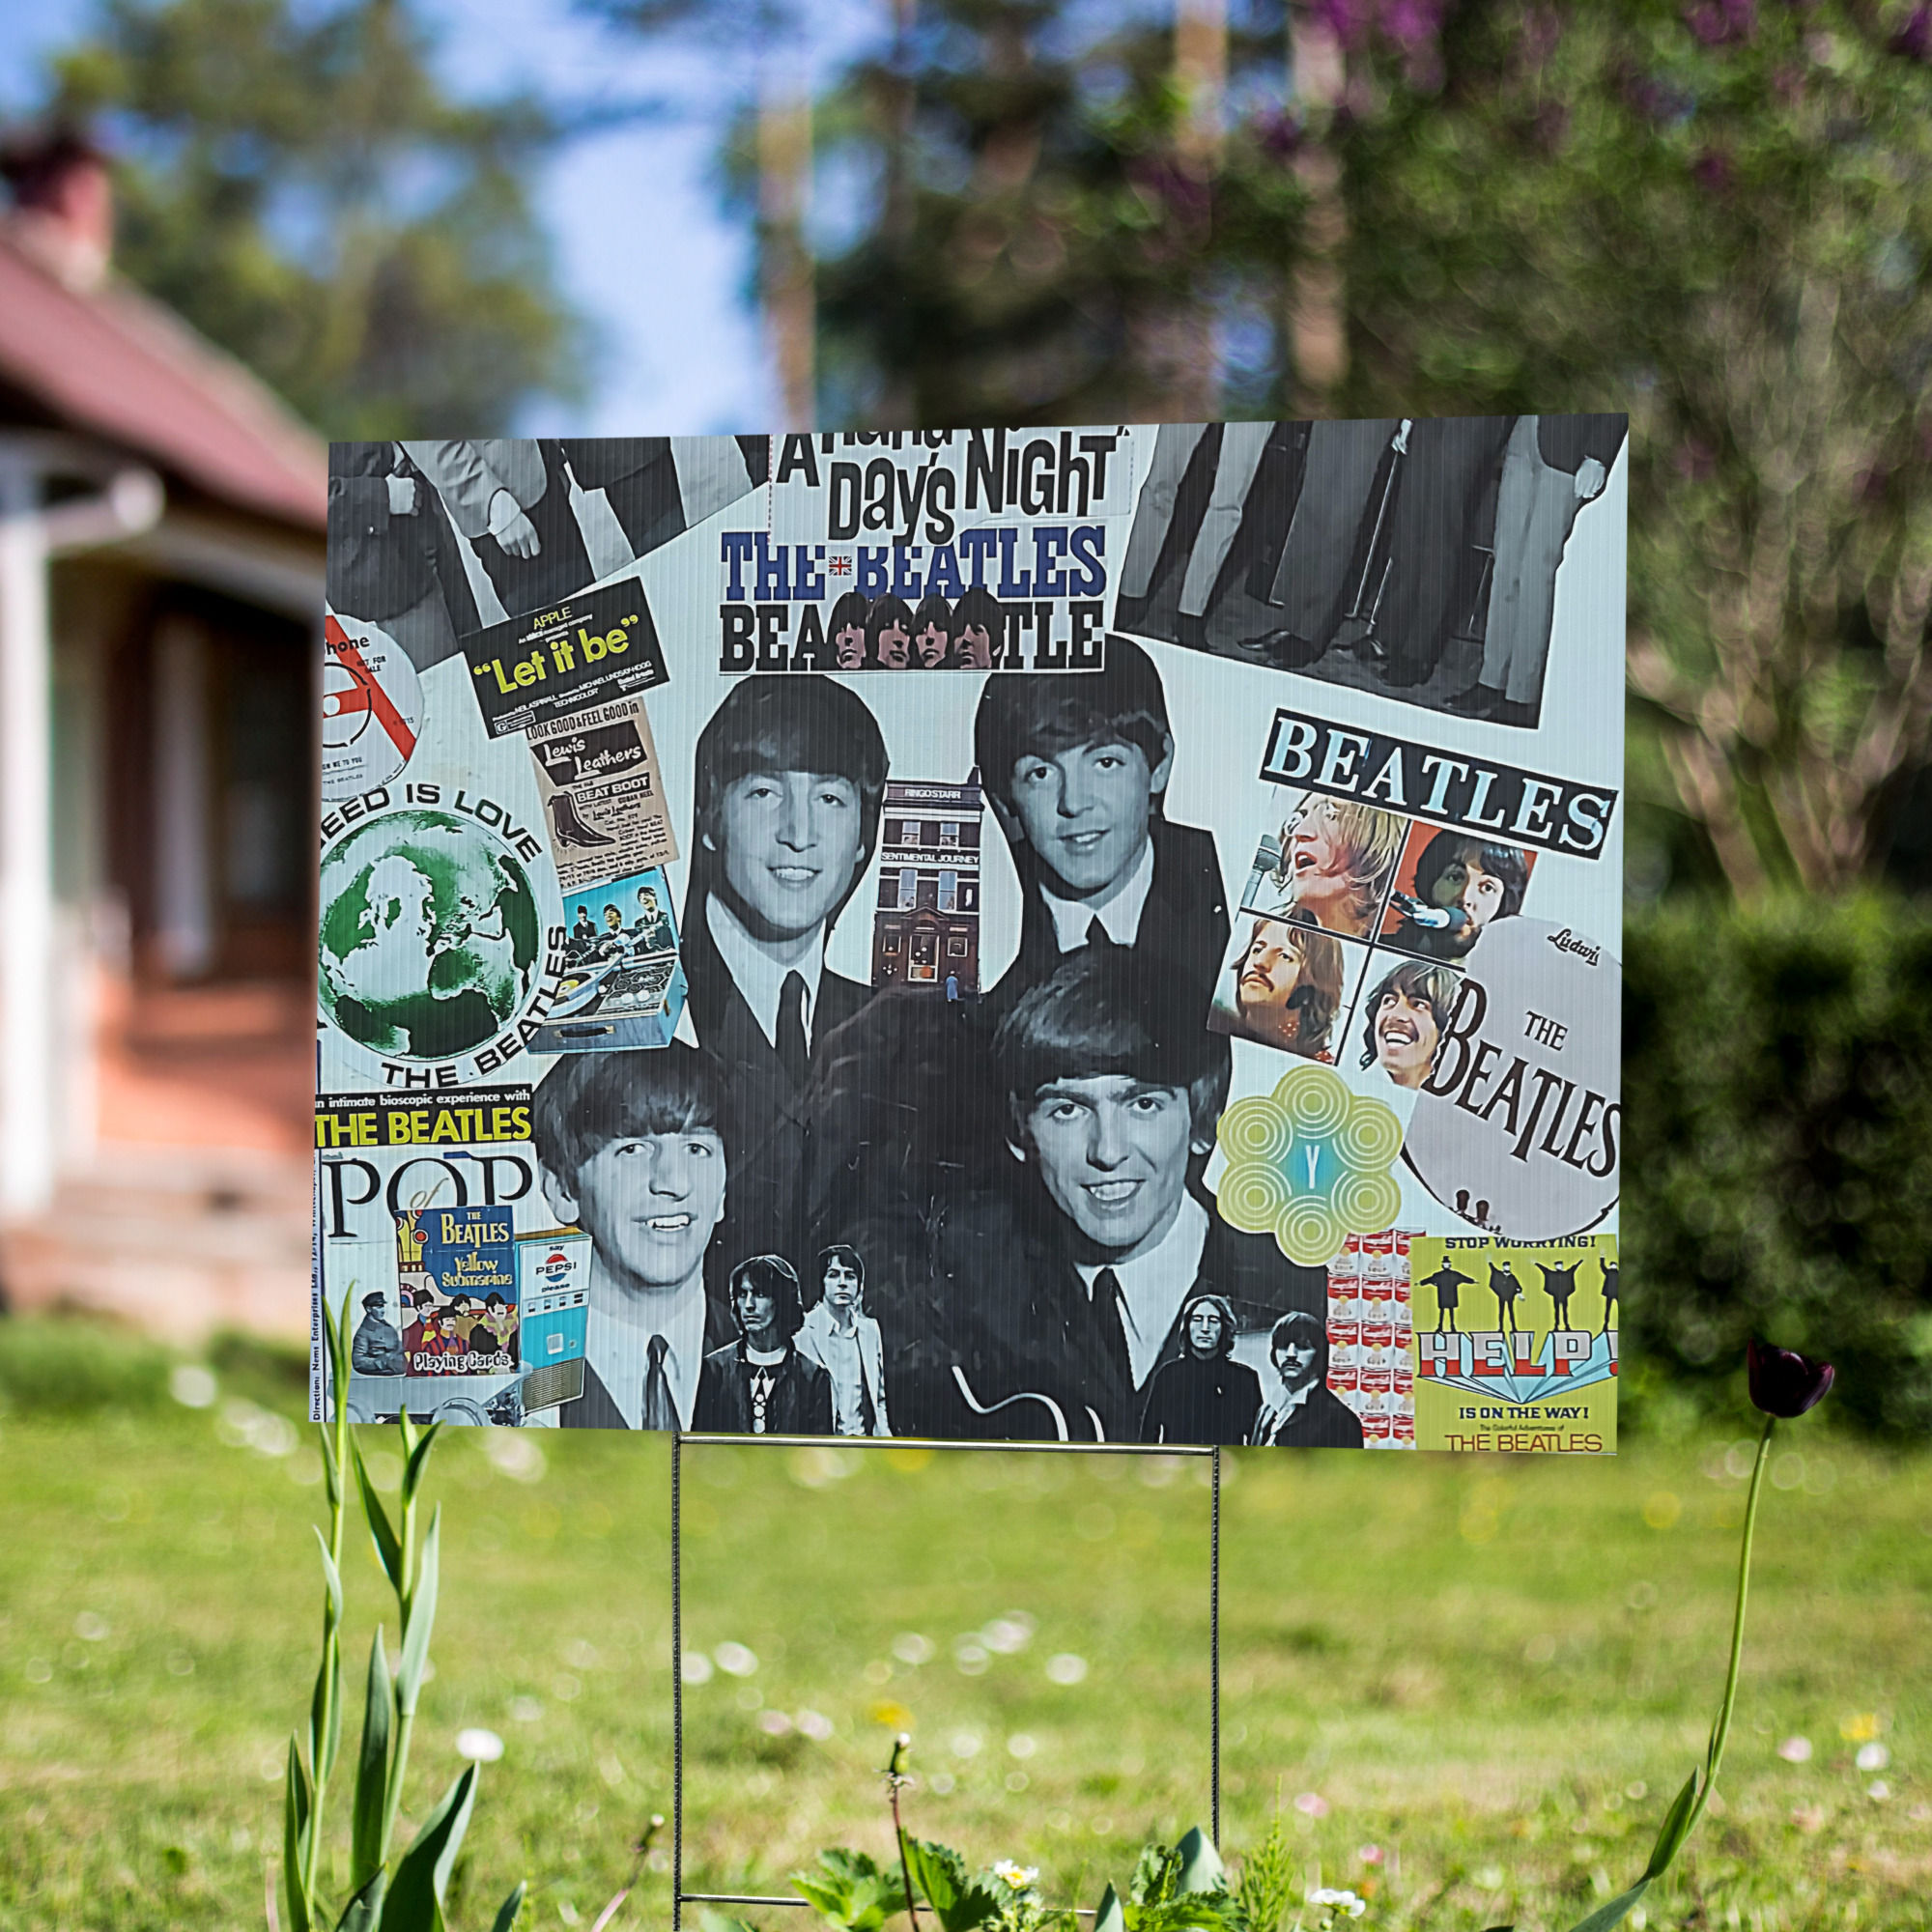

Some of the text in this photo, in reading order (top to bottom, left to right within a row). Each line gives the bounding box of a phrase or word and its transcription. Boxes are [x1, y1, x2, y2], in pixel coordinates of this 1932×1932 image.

[775, 433, 820, 487] A
[721, 526, 1107, 601] THE BEATLES
[533, 607, 572, 630] APPLE
[325, 637, 370, 655] hone
[550, 639, 576, 674] it
[496, 721, 508, 733] G
[526, 723, 551, 741] LOOK
[551, 716, 576, 734] GOOD
[582, 711, 604, 726] FEEL
[603, 702, 629, 722] GOOD
[628, 700, 639, 714] in
[543, 736, 586, 767] Lewis
[574, 746, 642, 781] Leathers
[577, 777, 648, 803] BEAT BOOT
[930, 789, 961, 799] STARR
[1264, 716, 1614, 851] BEATLES
[321, 787, 390, 850] EED
[406, 783, 440, 804] IS
[454, 790, 542, 863] LOVE
[881, 851, 980, 864] SENTIMENTAL JOURNEY
[381, 925, 567, 1089] THE BEATLES
[1524, 1010, 1568, 1051] THE
[1420, 977, 1621, 1178] BEATLES
[328, 1095, 376, 1108] intimate
[379, 1094, 433, 1107] bioscopic
[436, 1092, 500, 1107] experience
[503, 1089, 531, 1102] with
[315, 1106, 532, 1147] THE BEATLES
[1305, 1145, 1321, 1189] Y
[322, 1155, 532, 1238] POP
[410, 1177, 450, 1208] of
[440, 1212, 509, 1248] BEATLES
[1445, 1236, 1490, 1249] STOP
[441, 1271, 513, 1287] Submarine
[454, 1251, 498, 1276] Yellow
[535, 1262, 577, 1276] PEPSI
[541, 1283, 571, 1293] please
[311, 1293, 320, 1343] Enterprises
[414, 1350, 512, 1372] Playing Cards
[1414, 1330, 1618, 1378] HELP!
[312, 1377, 321, 1421] Direction:
[1459, 1406, 1590, 1420] IS ON THE WAY!
[1445, 1434, 1603, 1453] THE BEATLES
